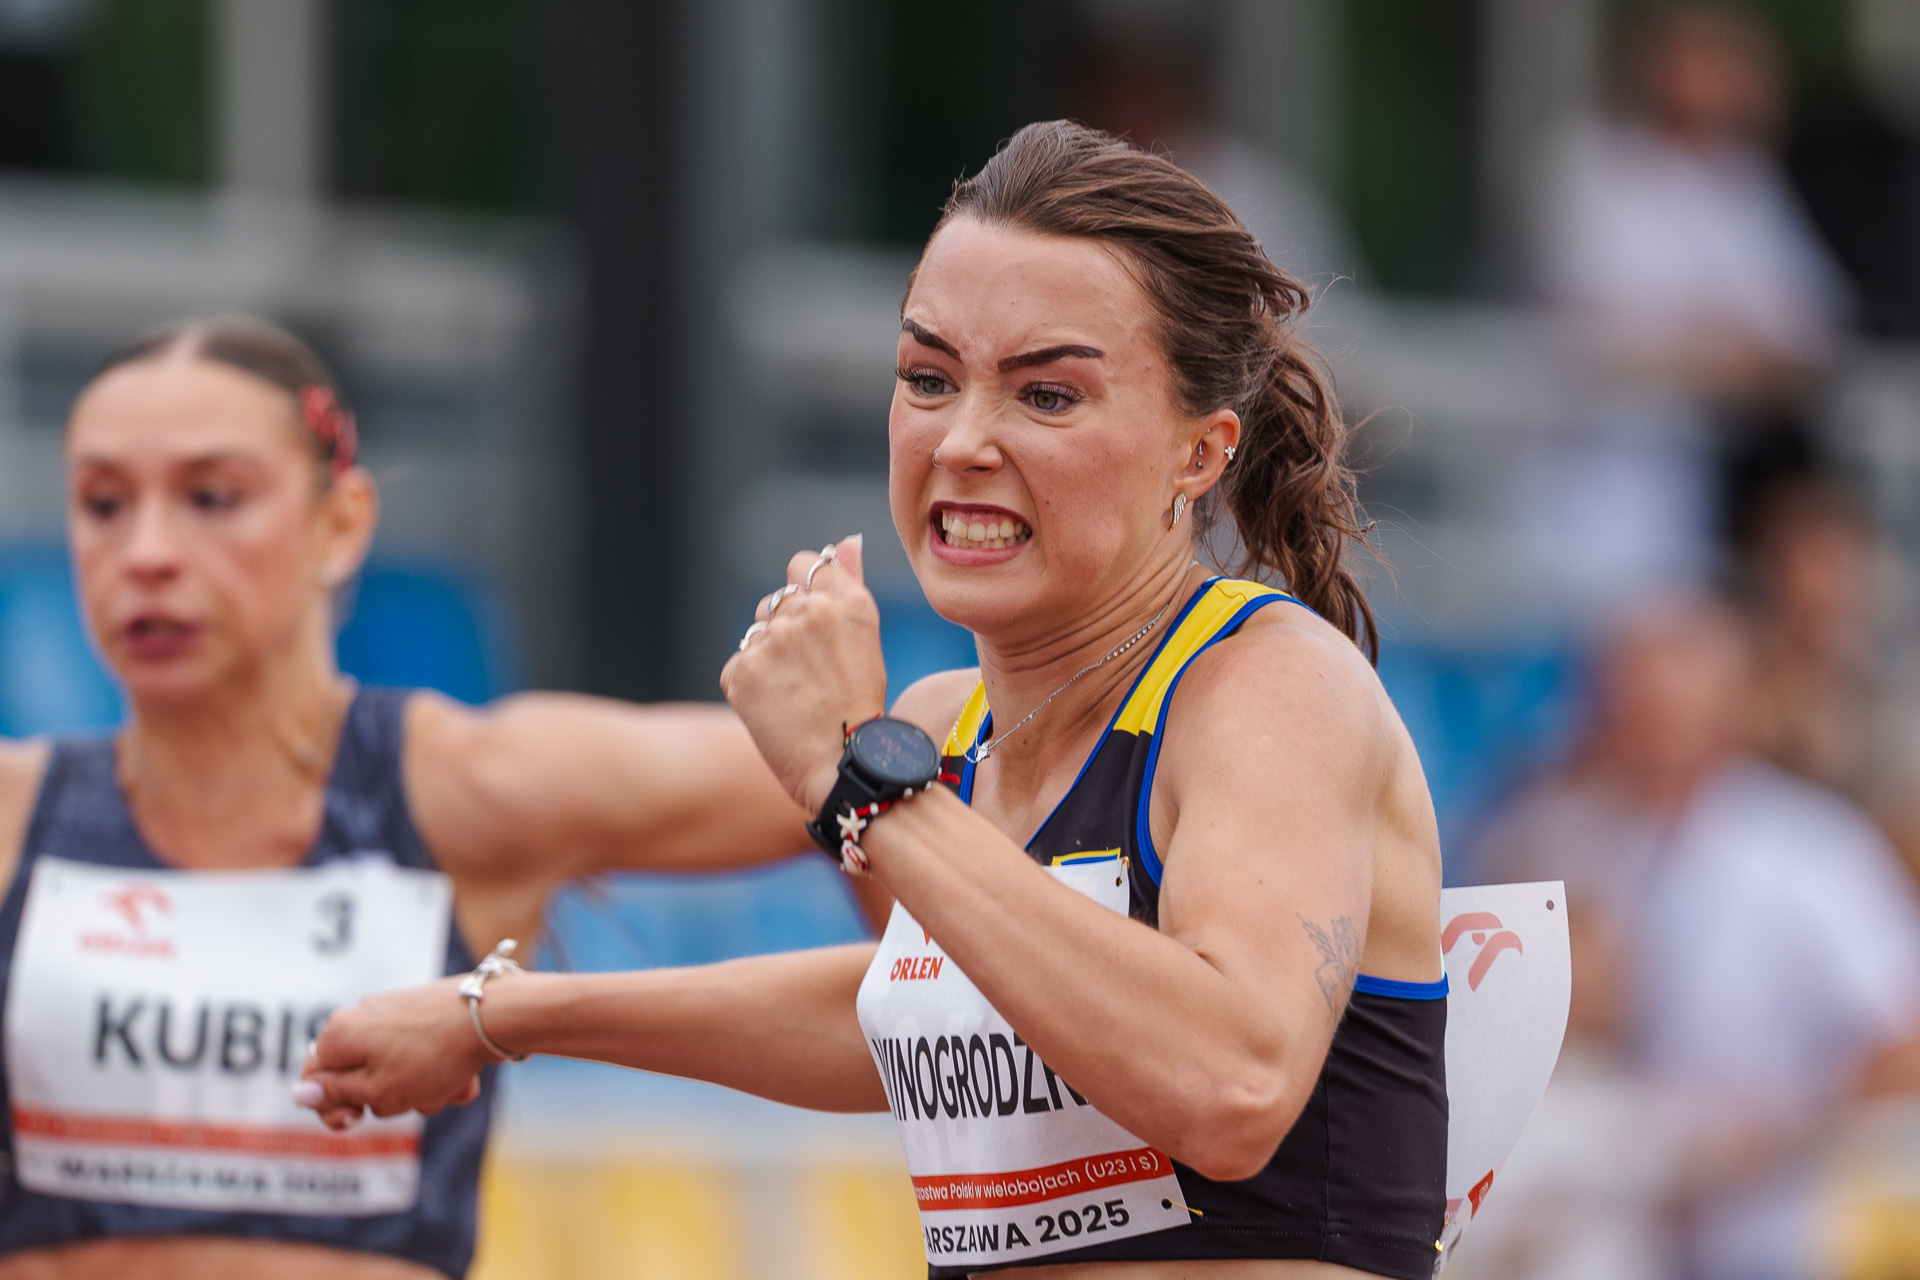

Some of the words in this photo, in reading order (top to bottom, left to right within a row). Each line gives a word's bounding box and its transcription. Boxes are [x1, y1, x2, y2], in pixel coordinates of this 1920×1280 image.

[311, 894, 354, 957] 3
[890, 956, 944, 982] ORLEN
[949, 1181, 974, 1200] Polski
[974, 1185, 982, 1199] w
[983, 1168, 1081, 1200] wielobojach
[1085, 1158, 1127, 1183] (U23
[1138, 1150, 1159, 1172] S)
[922, 1221, 1031, 1254] ARSZAWA
[1034, 1198, 1130, 1244] 2025
